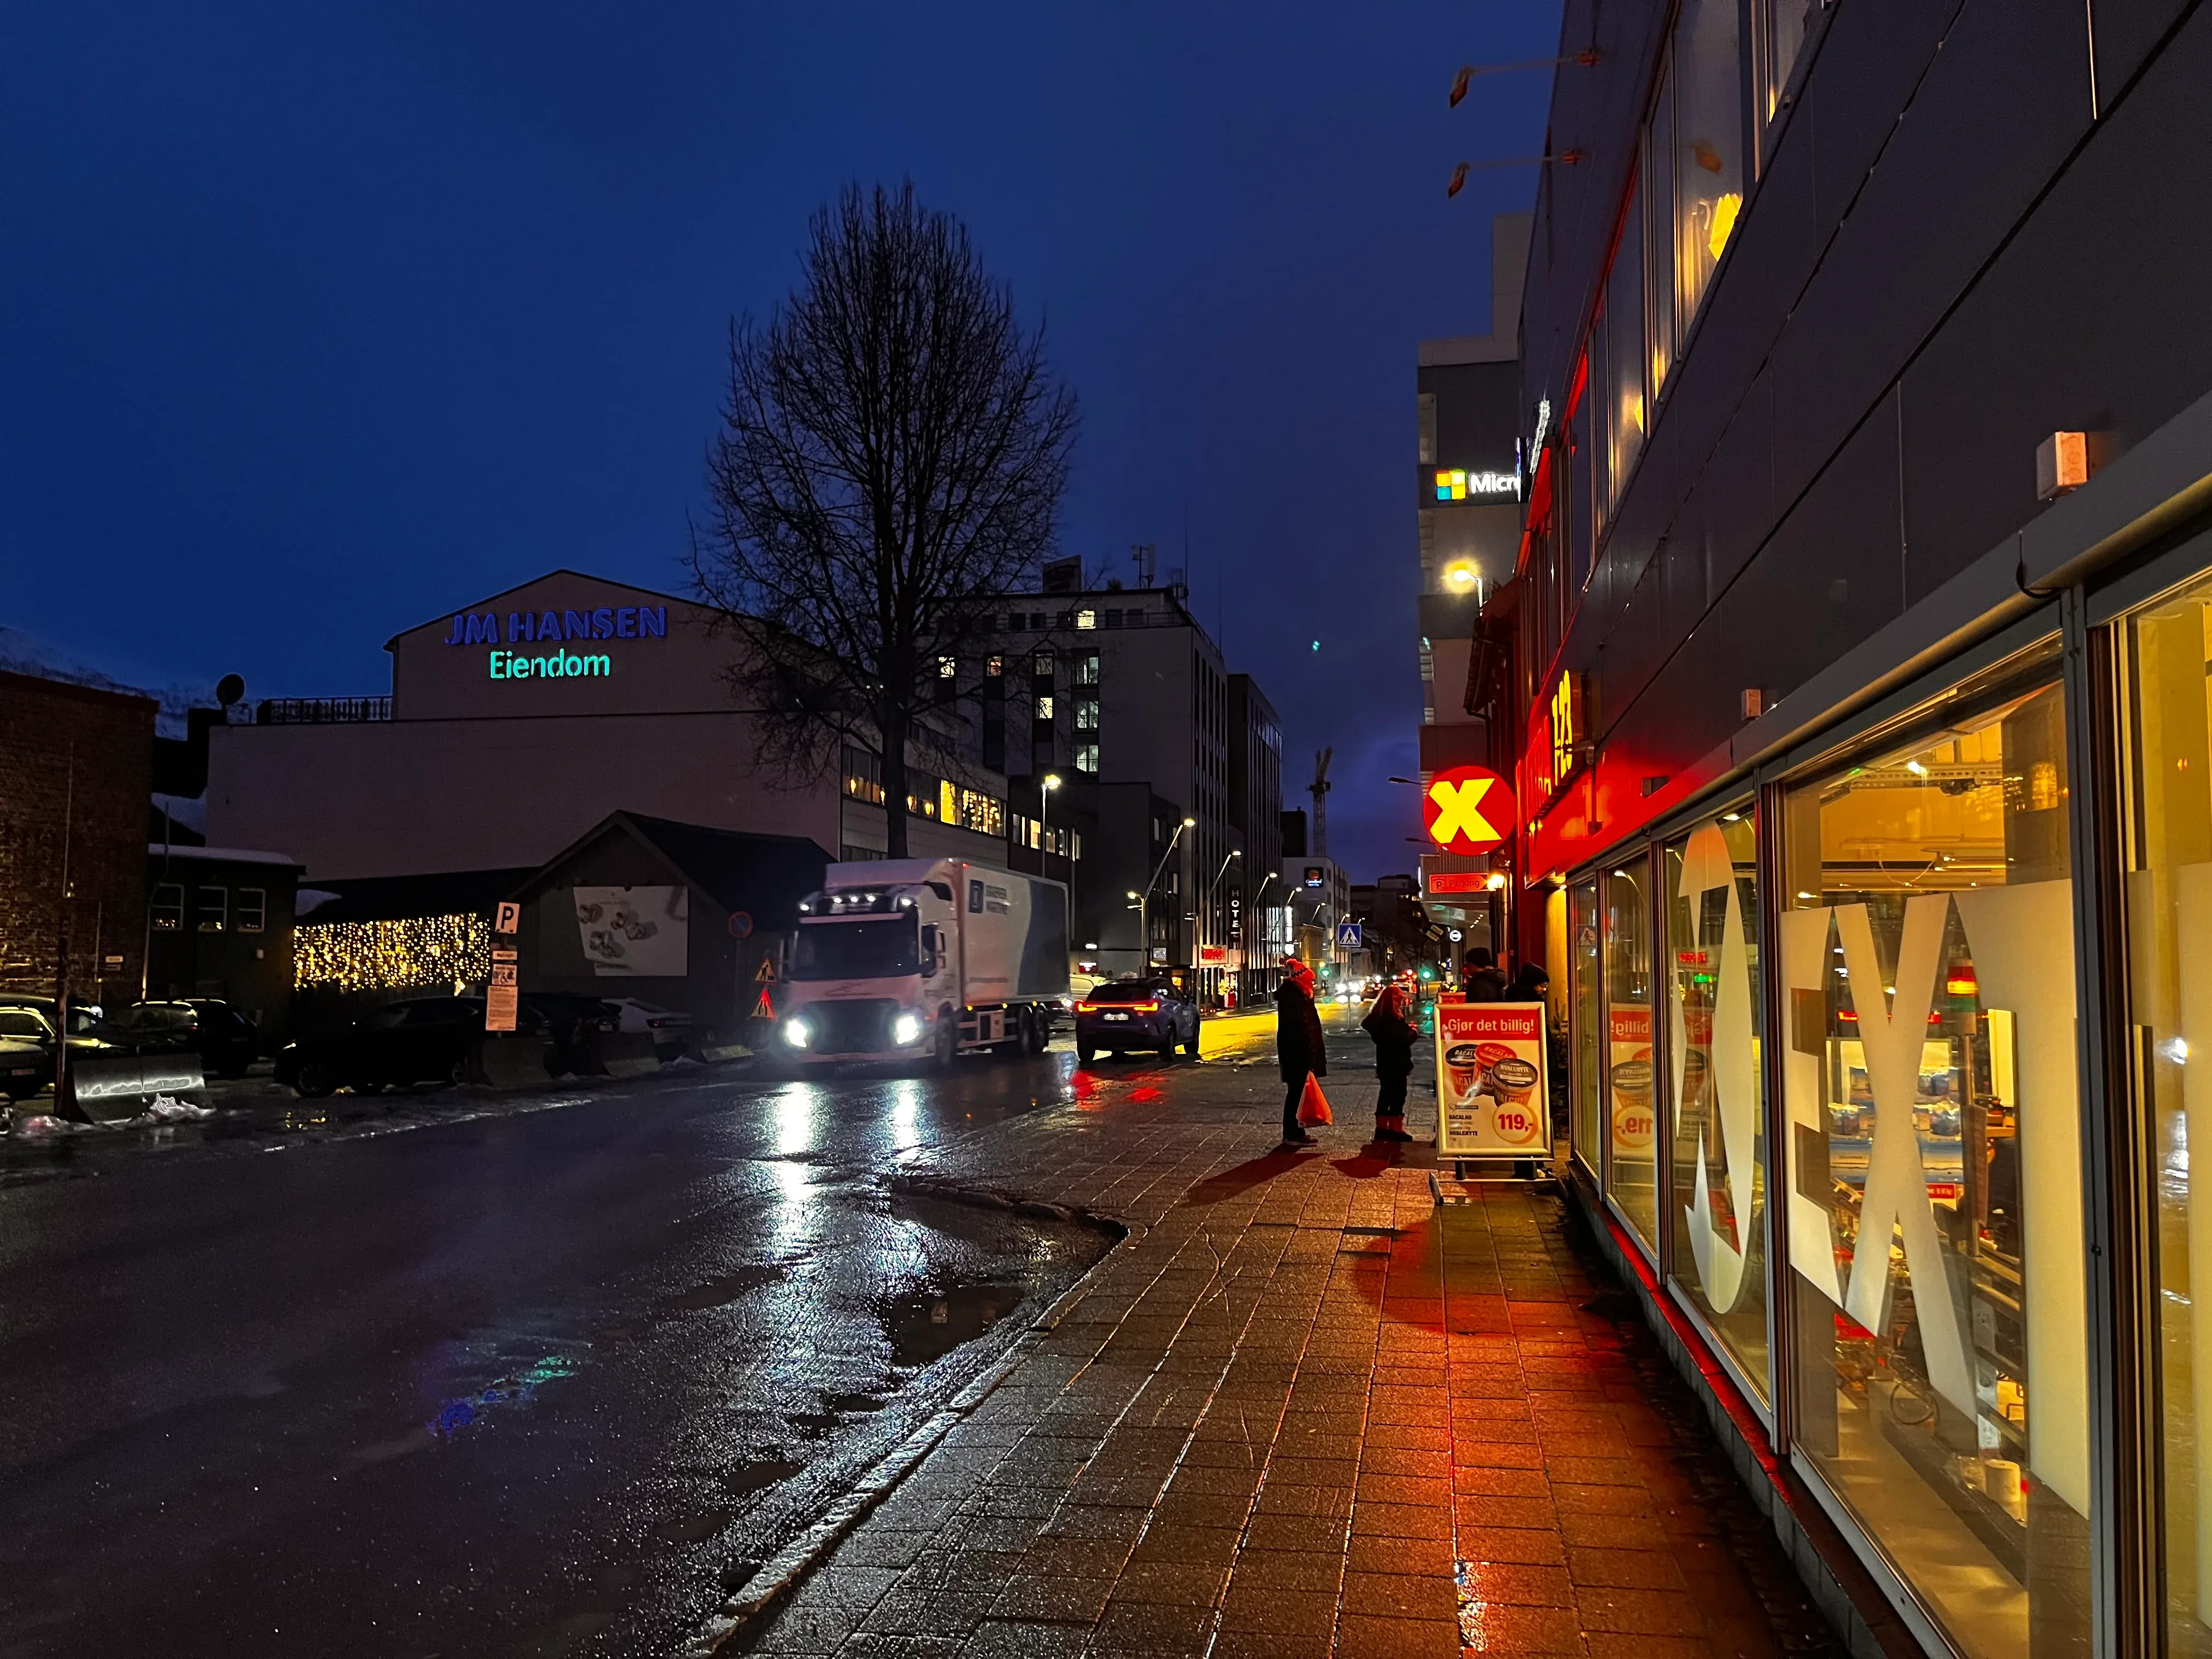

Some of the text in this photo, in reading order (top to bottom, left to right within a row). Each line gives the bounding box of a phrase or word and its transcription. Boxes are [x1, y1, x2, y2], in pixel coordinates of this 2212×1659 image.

[1470, 472, 1521, 494] Micr
[445, 606, 667, 645] JM HANSEN
[490, 648, 610, 679] Eiendom
[1428, 777, 1502, 844] X
[1449, 879, 1480, 888] Parking
[501, 906, 514, 929] P
[1231, 889, 1240, 938] HOTEL
[1448, 1019, 1534, 1034] Gjør det billig!
[1498, 1114, 1533, 1132] 119,-
